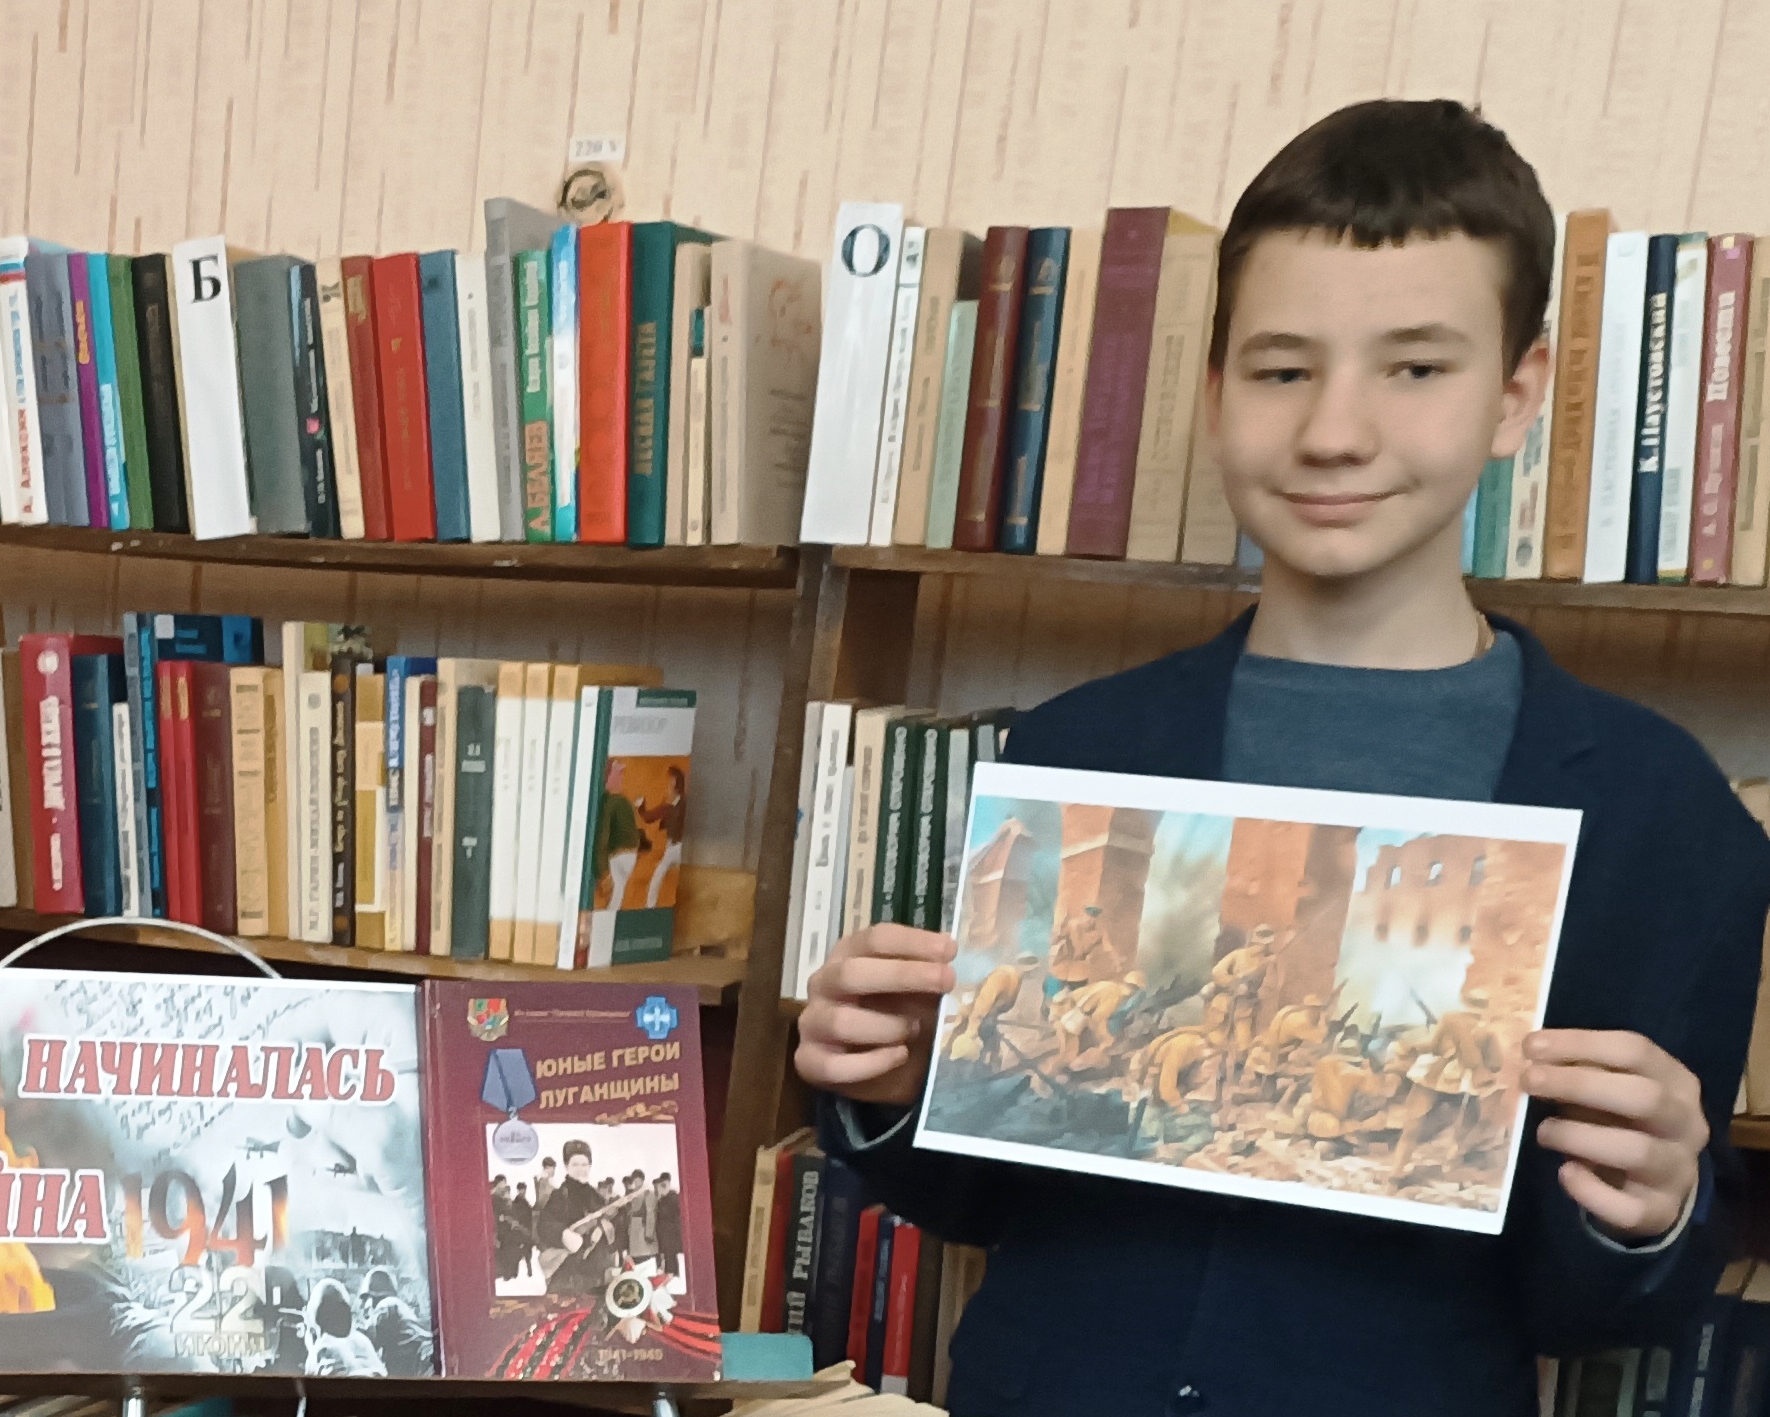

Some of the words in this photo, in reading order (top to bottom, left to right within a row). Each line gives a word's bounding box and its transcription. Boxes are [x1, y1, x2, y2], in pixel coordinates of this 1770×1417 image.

[190, 254, 222, 303] Б
[841, 223, 891, 278] О
[19, 1034, 399, 1105] НАЧИНАЛАСЬ
[536, 1050, 606, 1080] ЮНЫЕ
[612, 1041, 681, 1070] ГЕРОИ
[540, 1072, 679, 1110] ЛУГАНЩИНЫ
[123, 1163, 289, 1268] 1941
[792, 1170, 820, 1280] РЫБАКОВ
[171, 1266, 266, 1335] 22
